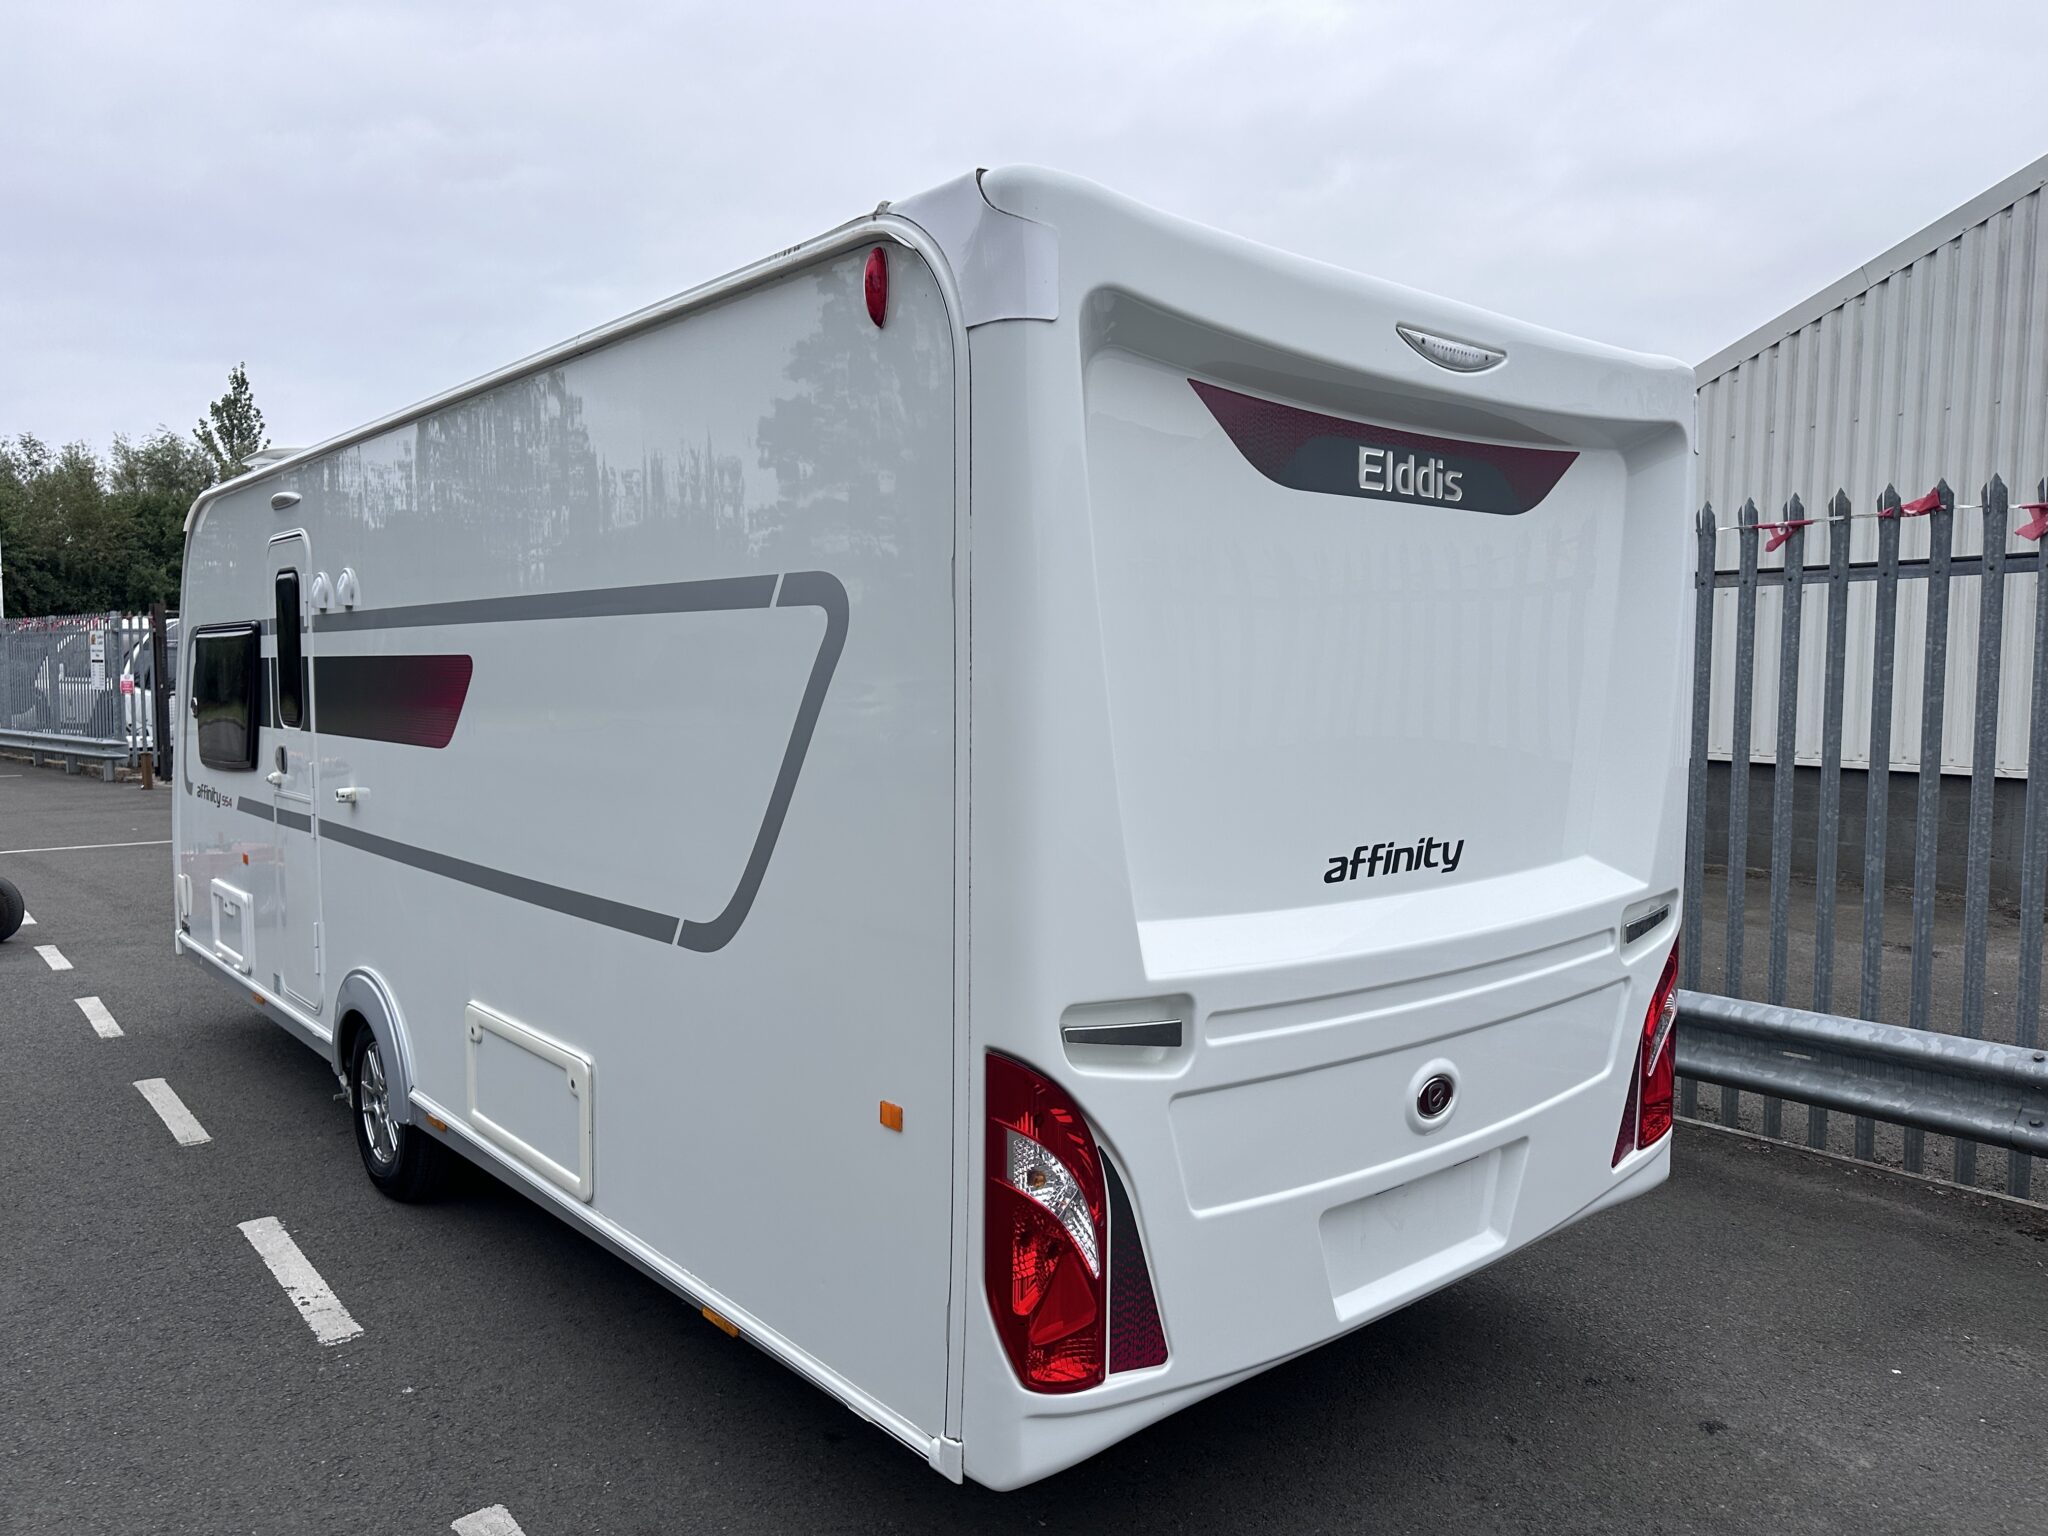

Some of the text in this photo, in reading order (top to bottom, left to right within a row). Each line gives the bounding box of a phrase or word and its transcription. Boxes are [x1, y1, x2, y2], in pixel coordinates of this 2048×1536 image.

[1359, 446, 1463, 502] Elddis
[197, 783, 221, 808] affinity
[1323, 836, 1465, 884] affinity
